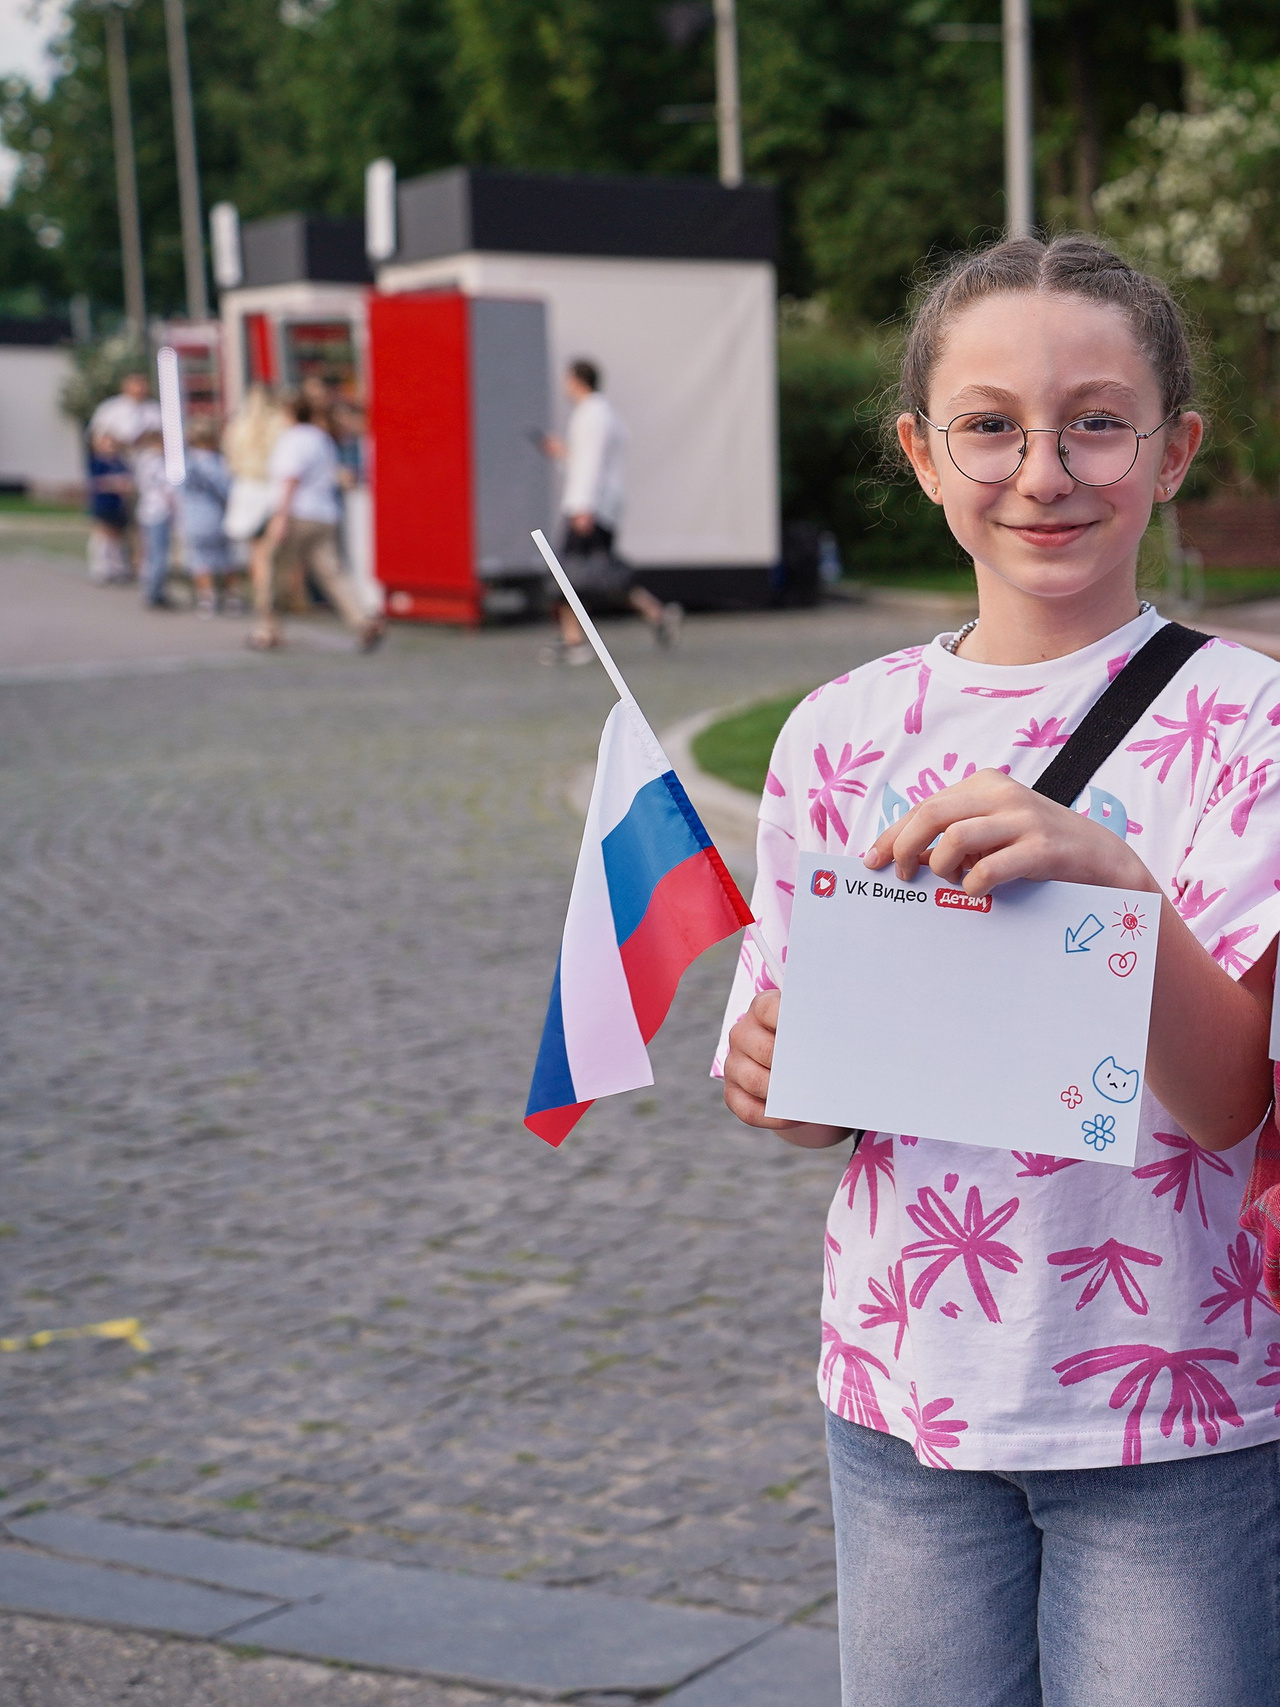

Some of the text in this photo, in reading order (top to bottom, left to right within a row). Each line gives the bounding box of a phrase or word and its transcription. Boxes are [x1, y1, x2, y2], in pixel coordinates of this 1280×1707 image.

[844, 879, 988, 911] VK Видео детям
